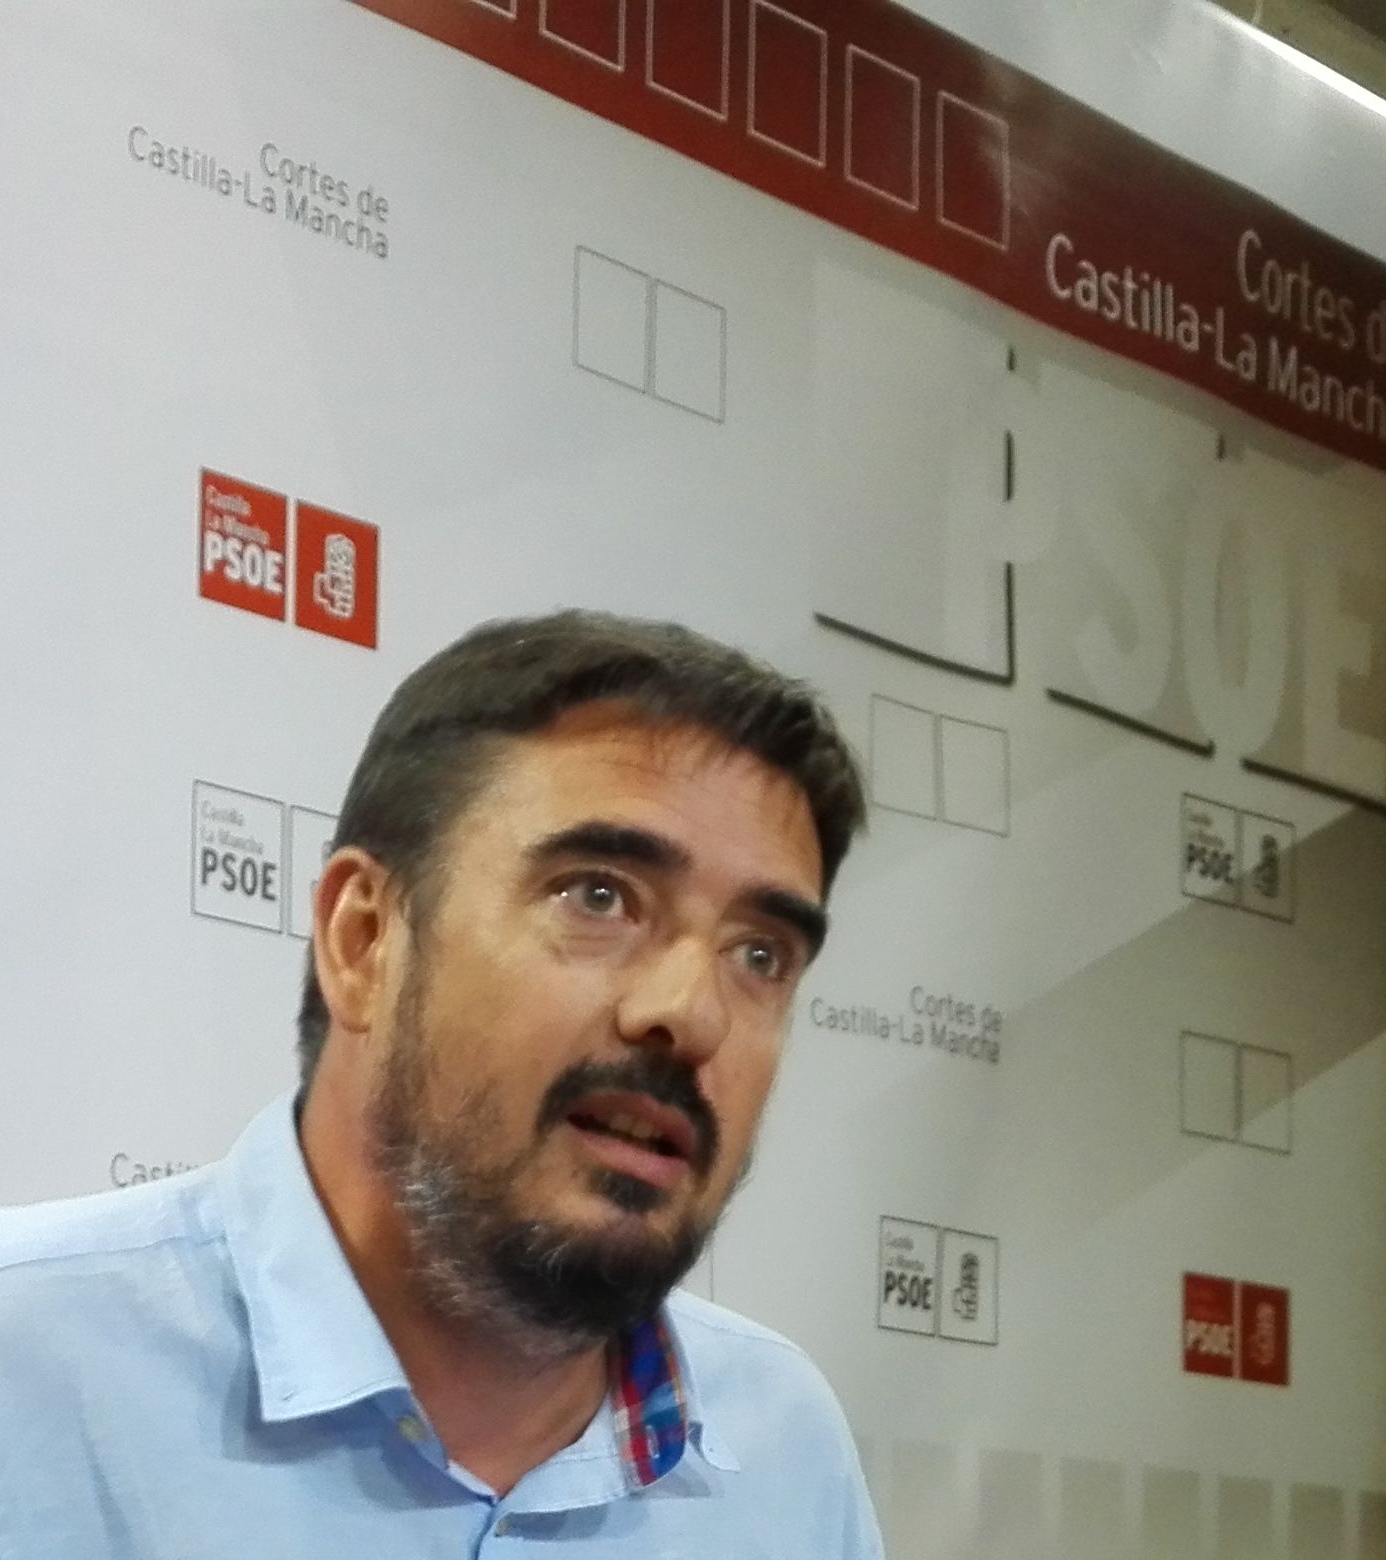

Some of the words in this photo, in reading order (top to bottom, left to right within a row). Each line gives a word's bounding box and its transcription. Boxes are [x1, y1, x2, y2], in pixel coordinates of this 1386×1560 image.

[128, 125, 277, 214] Castilla-La
[284, 187, 390, 260] Mancha
[259, 141, 351, 208] Cortes
[356, 184, 390, 223] de
[1045, 232, 1257, 381] Castilla-La
[1236, 229, 1357, 350] Cortes
[203, 529, 284, 594] PSOE
[200, 845, 278, 902] PSOE
[884, 1270, 933, 1310] PSOE
